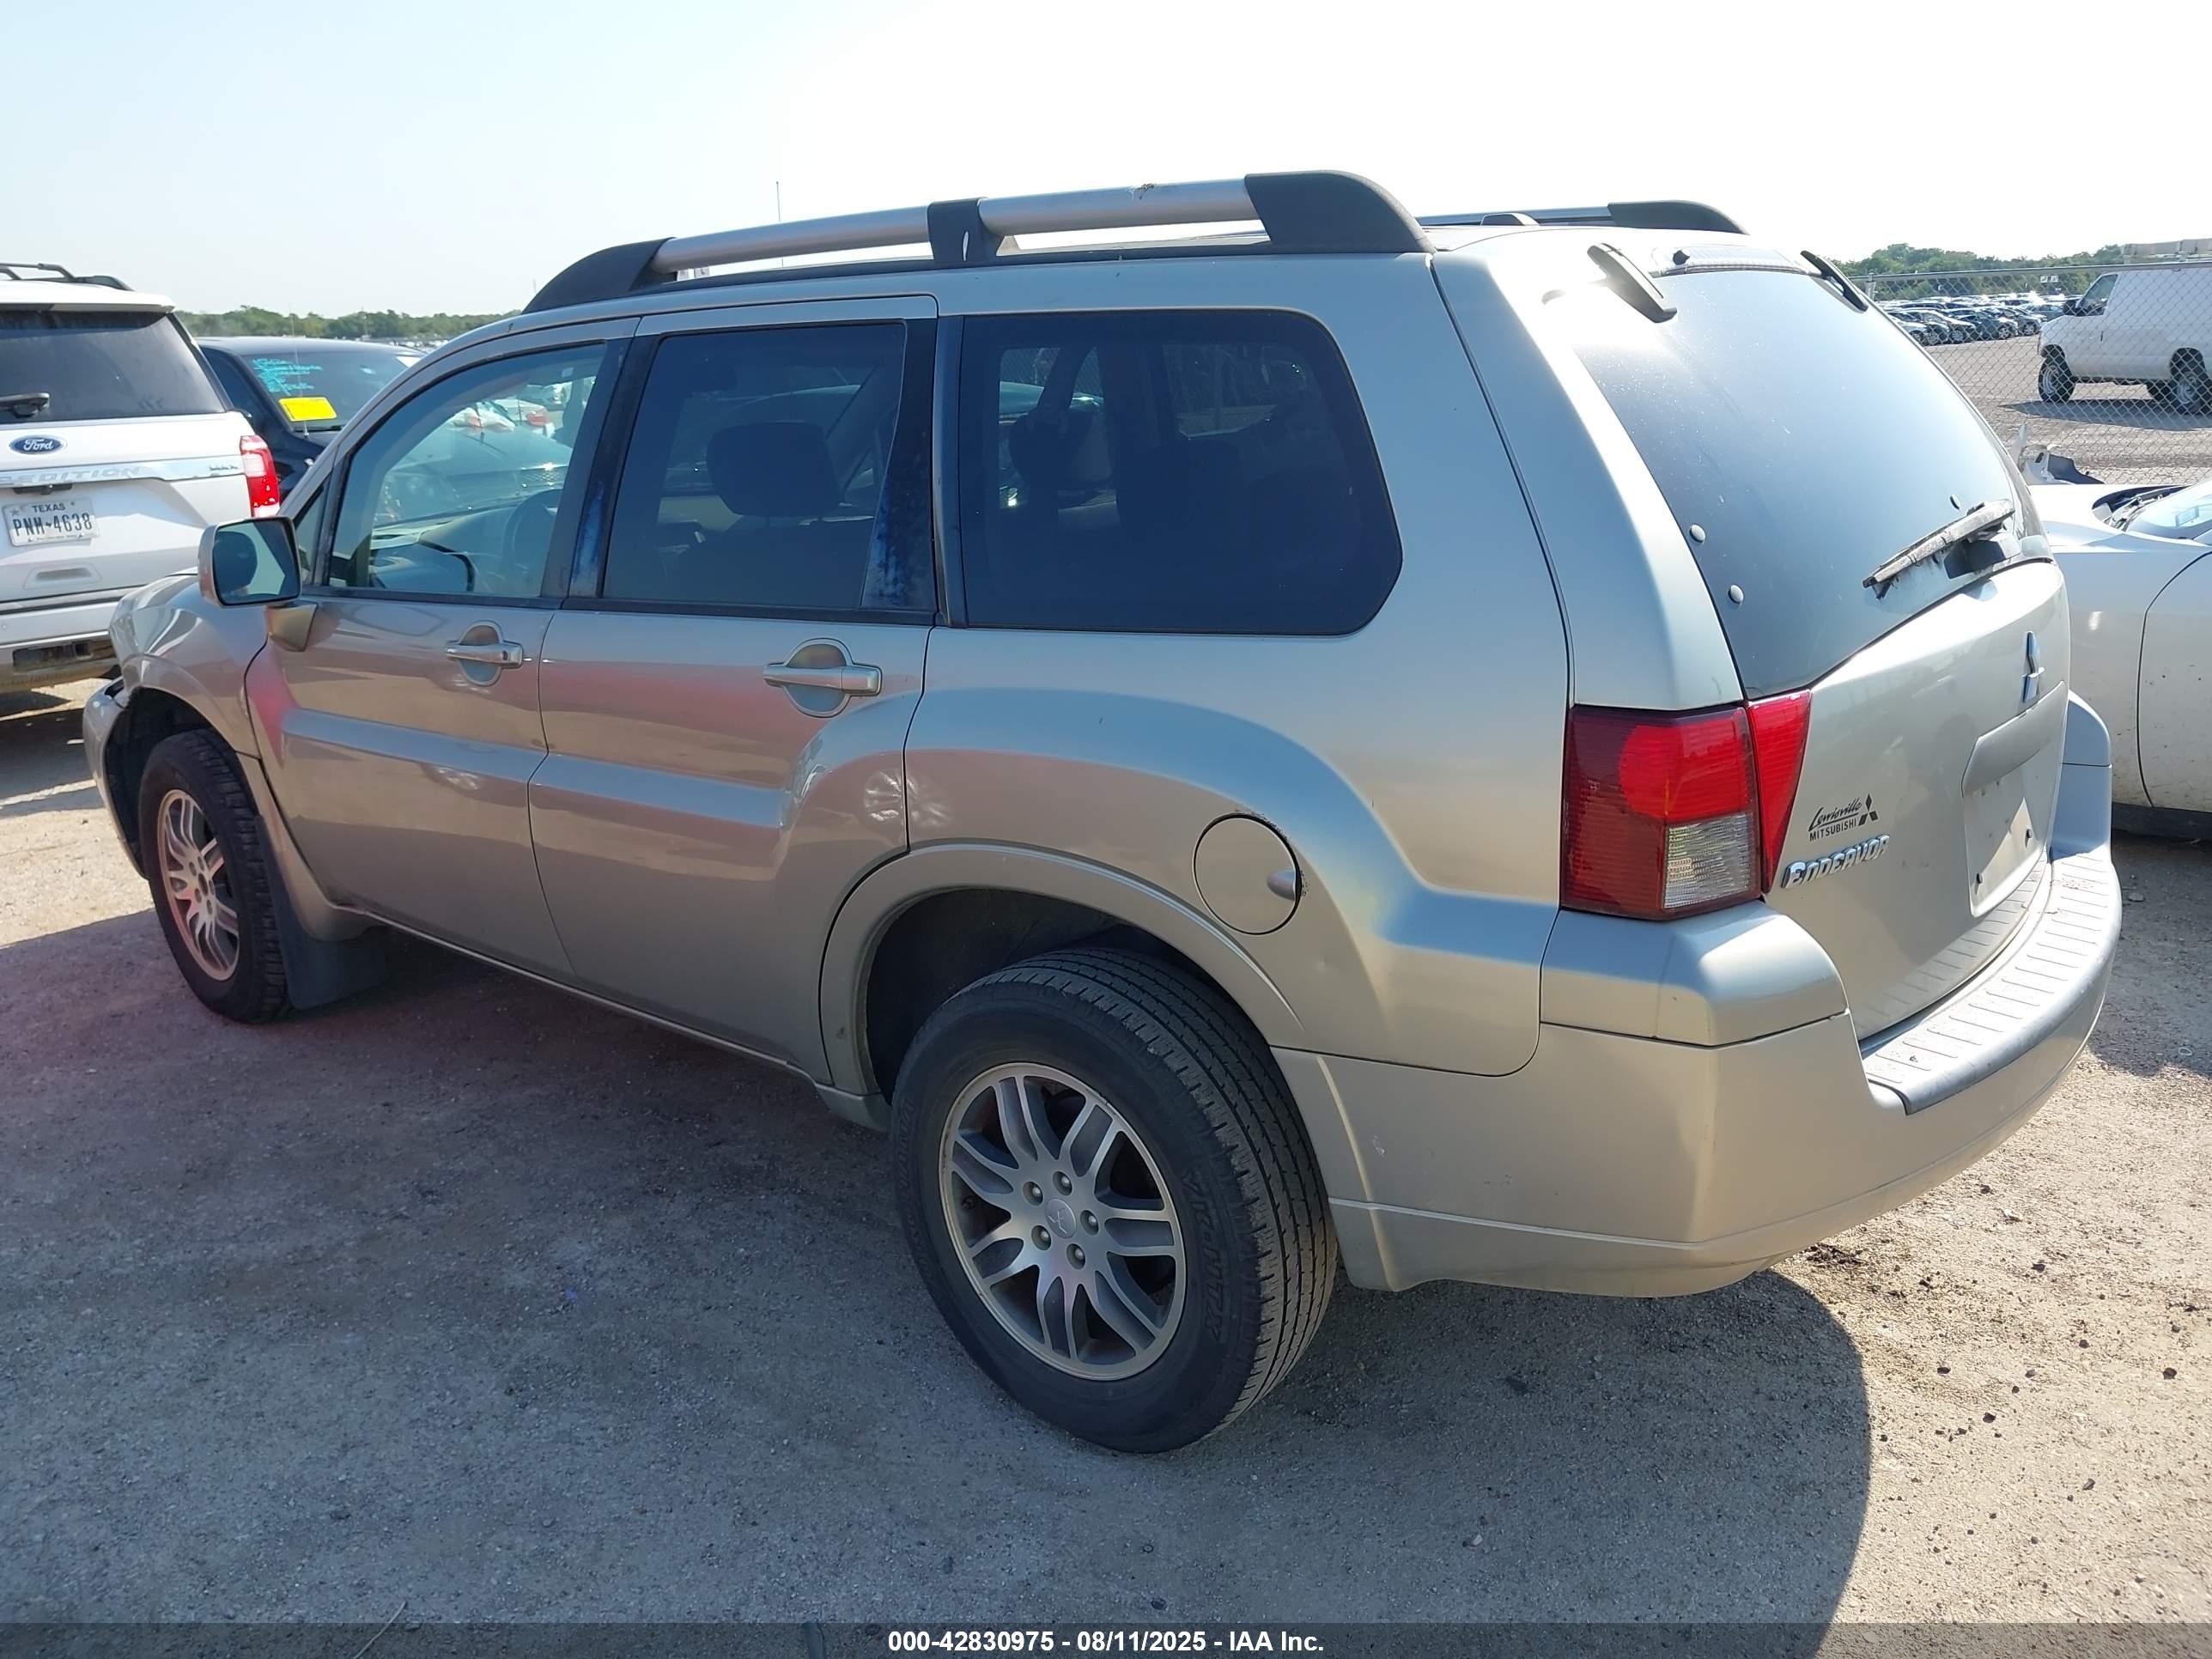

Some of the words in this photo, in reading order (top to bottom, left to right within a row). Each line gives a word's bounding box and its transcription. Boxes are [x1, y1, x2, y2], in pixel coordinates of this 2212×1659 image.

[23, 438, 54, 451] Ford
[32, 502, 66, 514] TEXAS
[1808, 797, 1863, 832] Lewisville
[1809, 818, 1856, 842] MITSUBISHI
